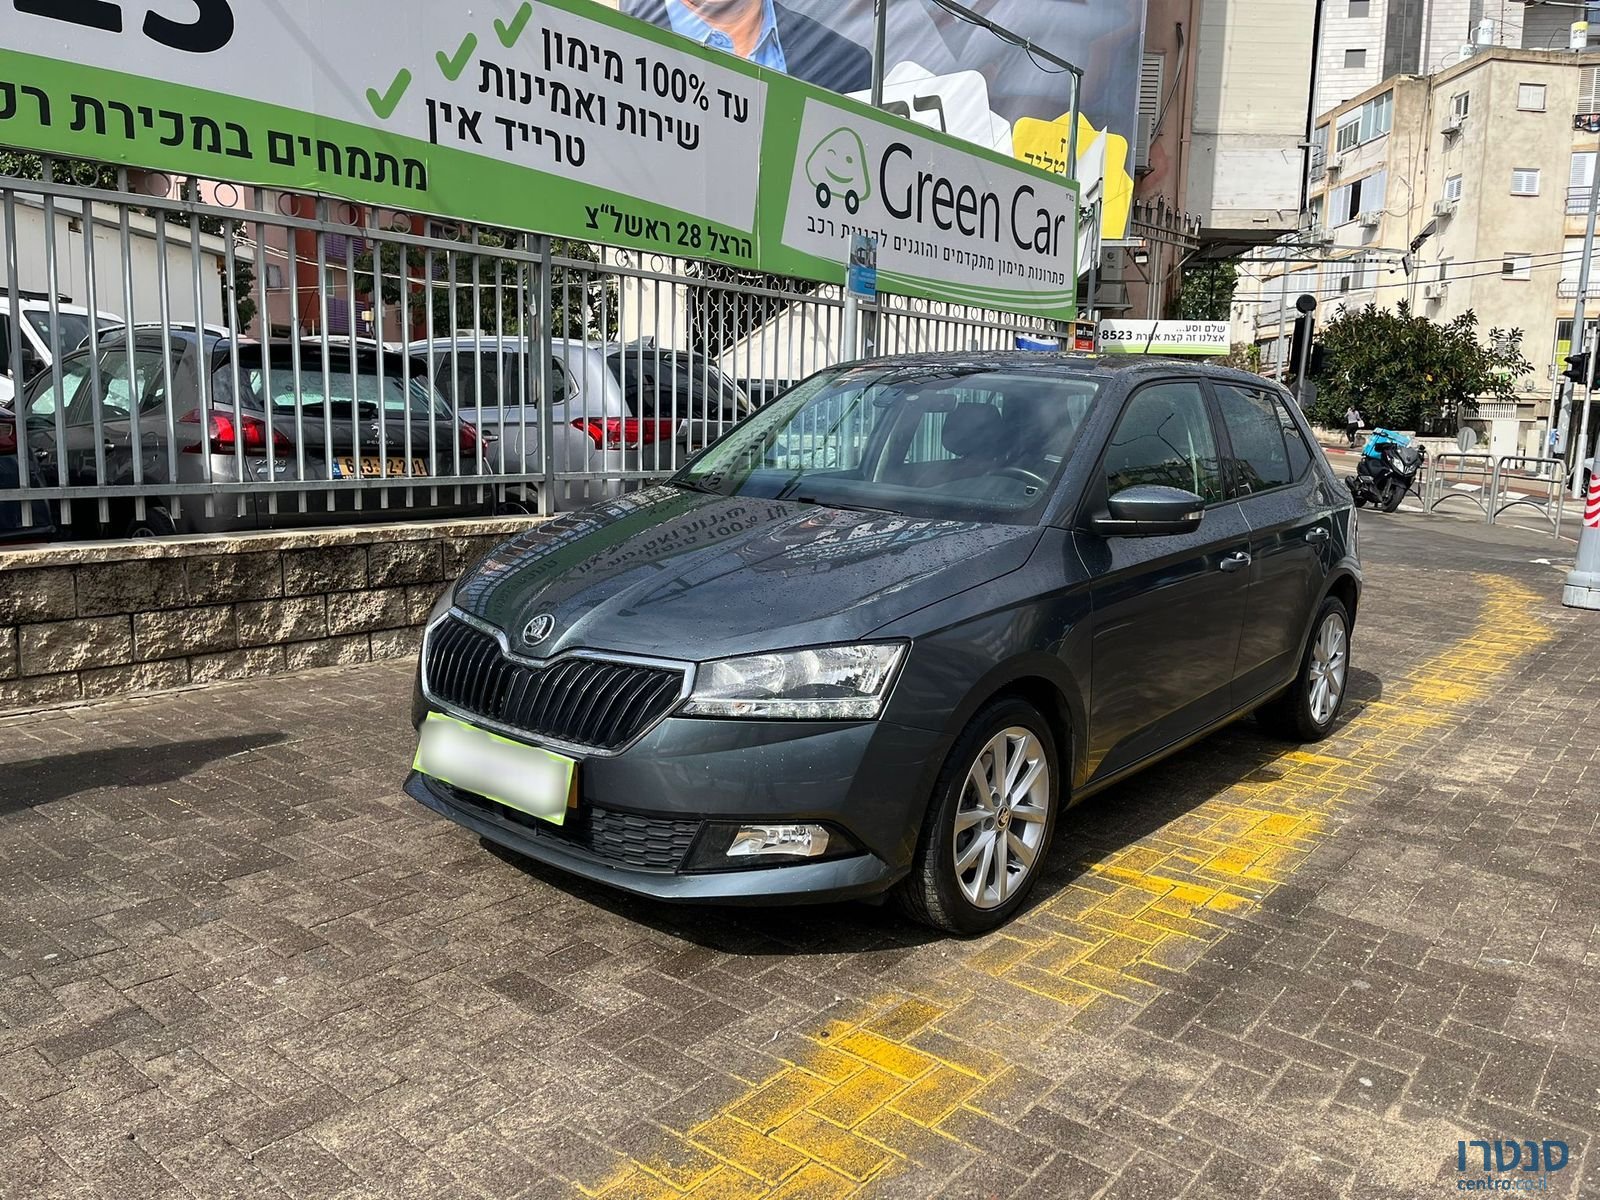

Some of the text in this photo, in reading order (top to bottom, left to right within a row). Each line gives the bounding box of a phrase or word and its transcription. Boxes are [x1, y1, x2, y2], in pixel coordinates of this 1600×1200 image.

[541, 27, 748, 123] עד 100% מימון
[478, 59, 700, 151] שירות ואמינות
[69, 93, 253, 160] במכירת
[425, 98, 586, 167] טרייד אין
[267, 129, 428, 192] מתמחים
[879, 142, 1067, 257] Green Car
[676, 221, 702, 249] 28
[807, 216, 834, 236] רכב
[707, 225, 752, 259] הרצל
[894, 236, 938, 259] והוגנים
[943, 247, 994, 270] מתקדמים
[998, 259, 1024, 276] מימון
[1027, 266, 1065, 285] פתרונות
[1164, 334, 1183, 344] קצת
[1185, 334, 1197, 342] זה
[1199, 332, 1225, 343] אצלנו
[1204, 322, 1226, 333] שלם
